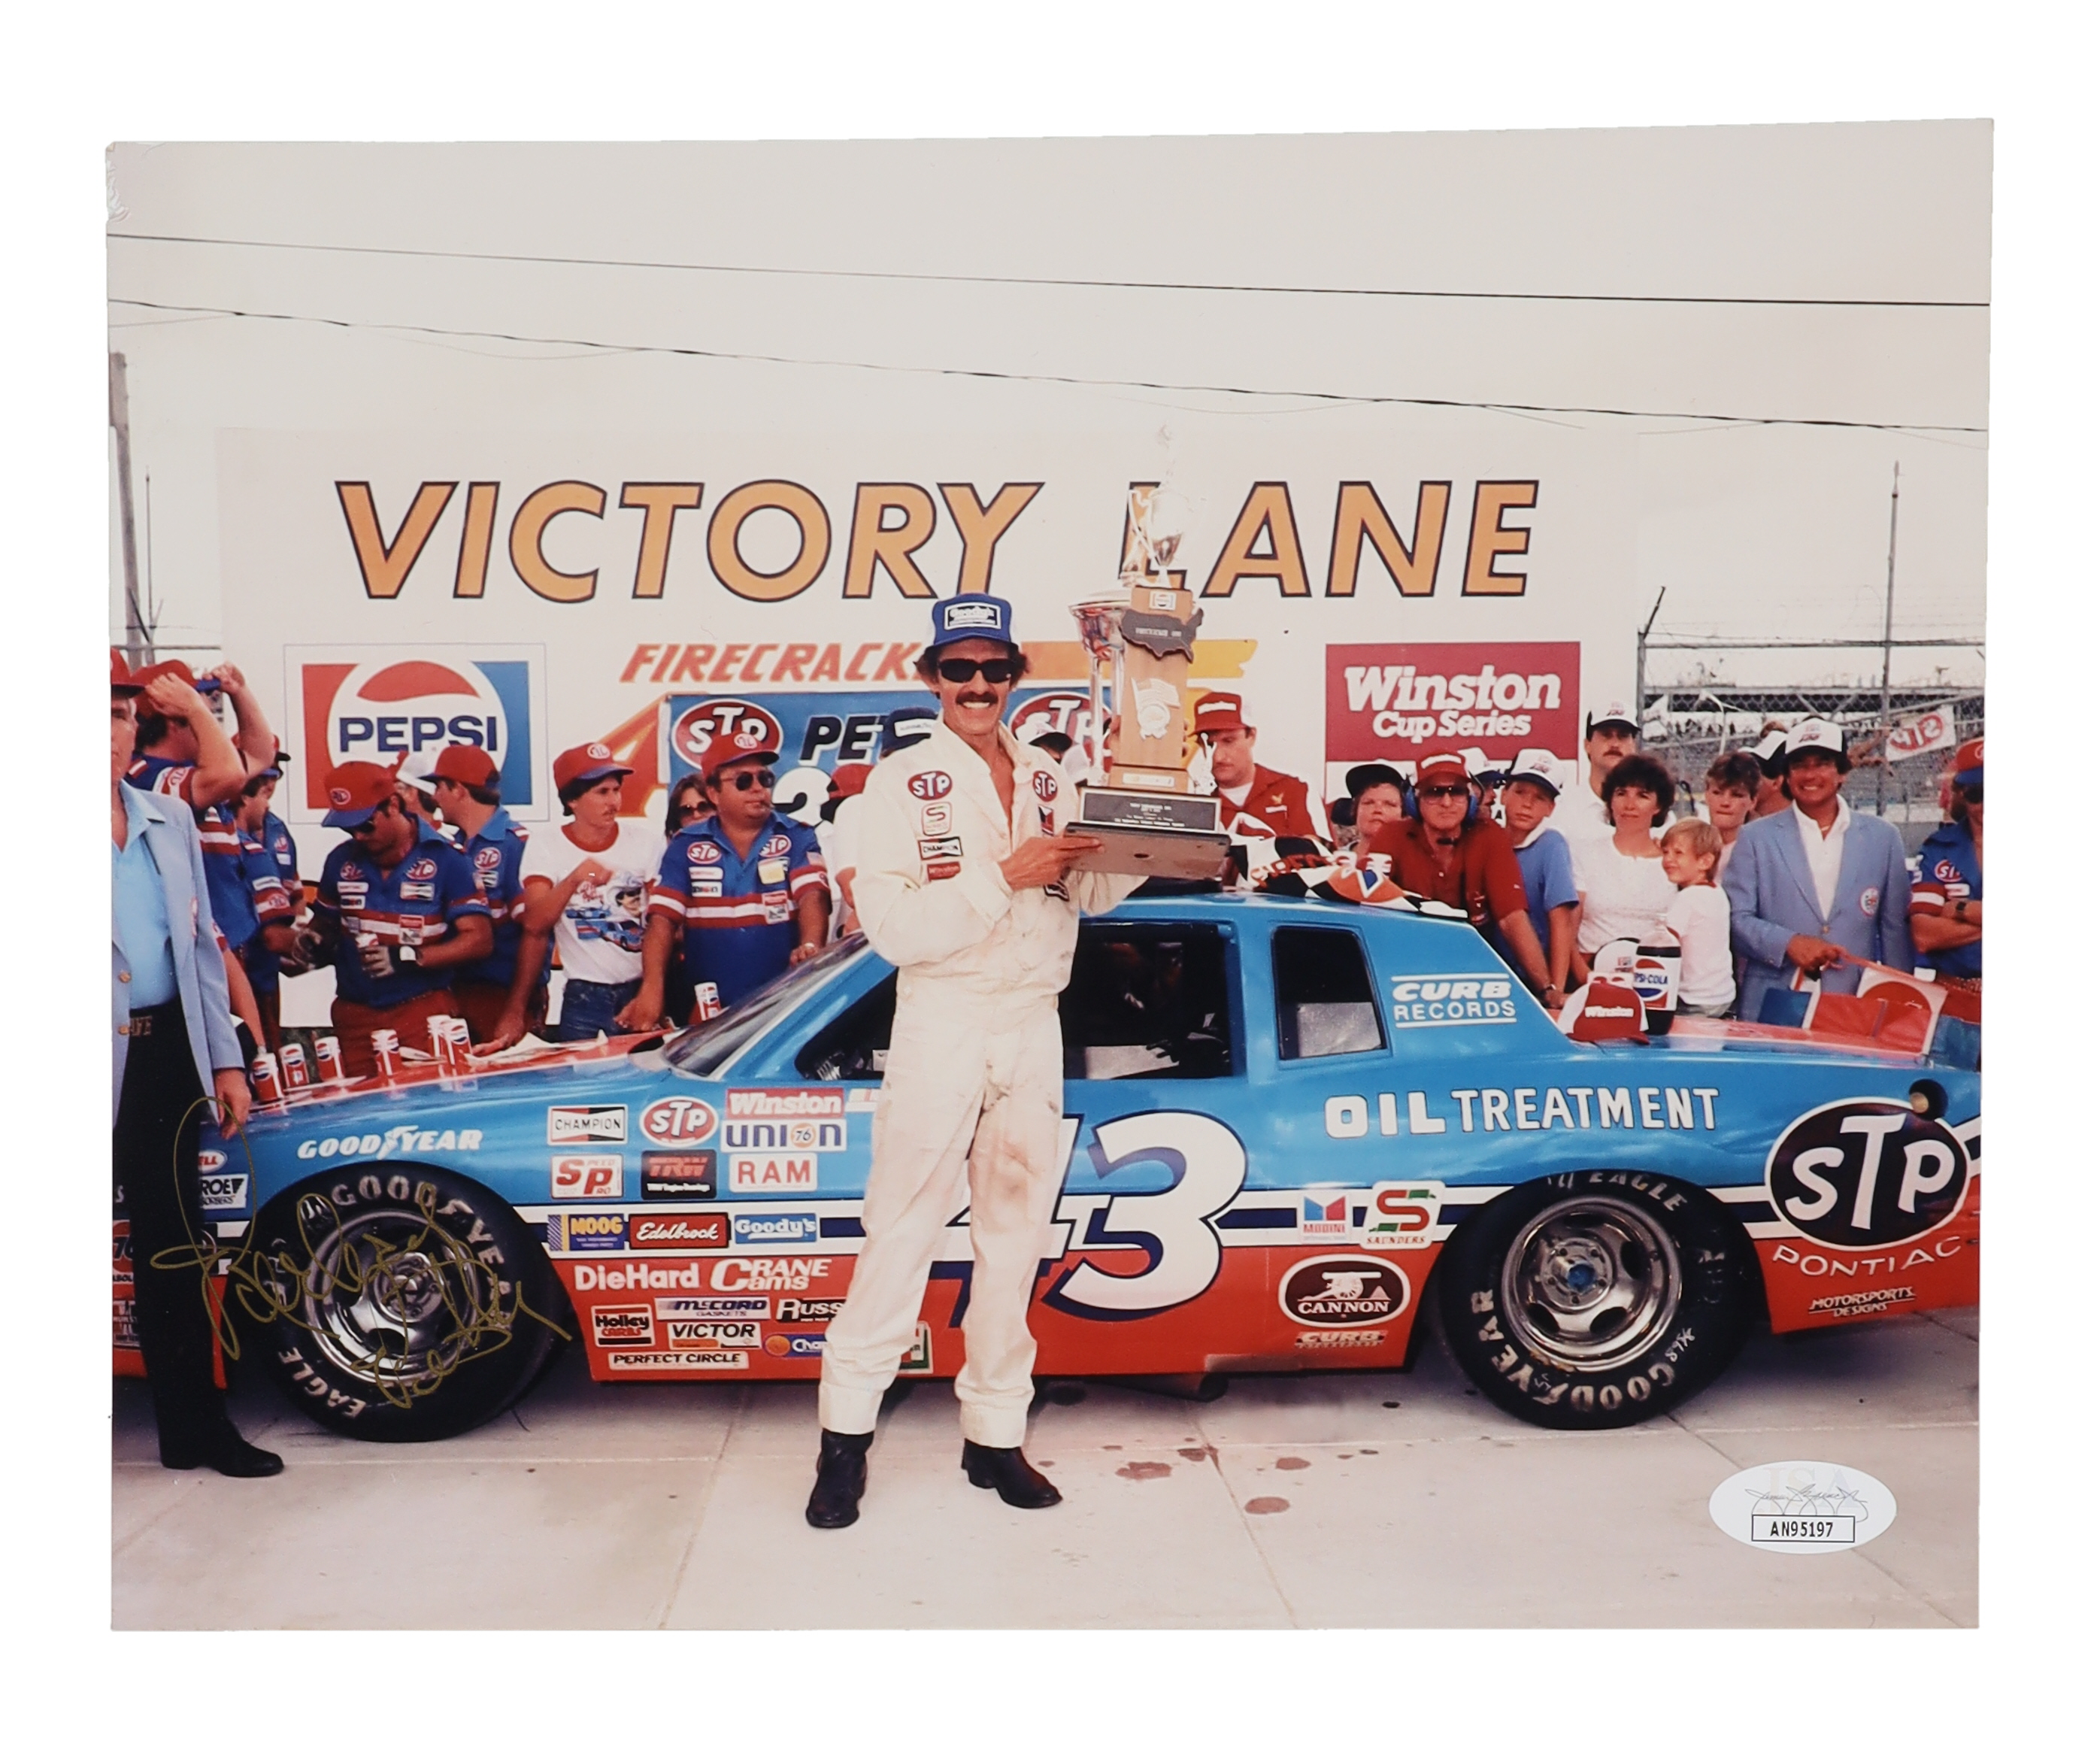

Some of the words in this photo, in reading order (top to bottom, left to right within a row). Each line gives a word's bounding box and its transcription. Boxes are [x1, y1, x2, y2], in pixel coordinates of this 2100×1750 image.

[335, 479, 1045, 604] VICTORY
[1118, 480, 1540, 598] LANE
[619, 642, 925, 683] FIRECRACK
[1344, 665, 1562, 711] Winston
[339, 716, 497, 752] PEPSI
[686, 707, 767, 754] STP
[1372, 711, 1434, 745] Cup
[1437, 709, 1532, 736] Series
[798, 714, 887, 766] PE
[912, 772, 950, 797] STP
[1035, 772, 1056, 797] STP
[477, 851, 499, 868] STP
[690, 844, 719, 860] STP
[1634, 972, 1668, 984] PSI-COLA
[1392, 981, 1511, 1002] CURB
[1393, 1000, 1516, 1021] RECORDS
[729, 1092, 842, 1115] Winston
[1324, 1090, 1447, 1139] OIL
[1451, 1087, 1720, 1133] TREATMENT
[555, 1118, 622, 1131] CHAMPION
[650, 1101, 708, 1137] STP
[297, 1125, 483, 1160] GOODYEAR
[647, 1156, 709, 1178] TRW
[738, 1160, 811, 1184] RAM
[1785, 1113, 1956, 1230] STP
[201, 1178, 232, 1196] ROE
[1589, 1171, 1688, 1212] EAGLE
[571, 1216, 623, 1235] MOOG
[636, 1221, 720, 1241] Edelbrock
[735, 1218, 817, 1239] Goody's
[1366, 1236, 1426, 1245] SAUNDERS
[1773, 1236, 1962, 1277] PONTIAC
[574, 1262, 700, 1291] DieHard
[711, 1258, 832, 1292] CRANE
[776, 1299, 843, 1320] RUSS
[1298, 1301, 1390, 1314] CANNON
[1808, 1286, 1916, 1310] MOTORSPORTS
[1833, 1302, 1888, 1318] DESIGNS
[595, 1315, 650, 1330] Holley
[672, 1324, 756, 1338] VICTOR
[613, 1353, 683, 1363] PERFECT
[685, 1353, 741, 1363] CIRCLE
[1471, 1289, 1676, 1412] GOODYEAR
[278, 1347, 367, 1418] EAGLE
[1769, 1521, 1834, 1539] AN95197
